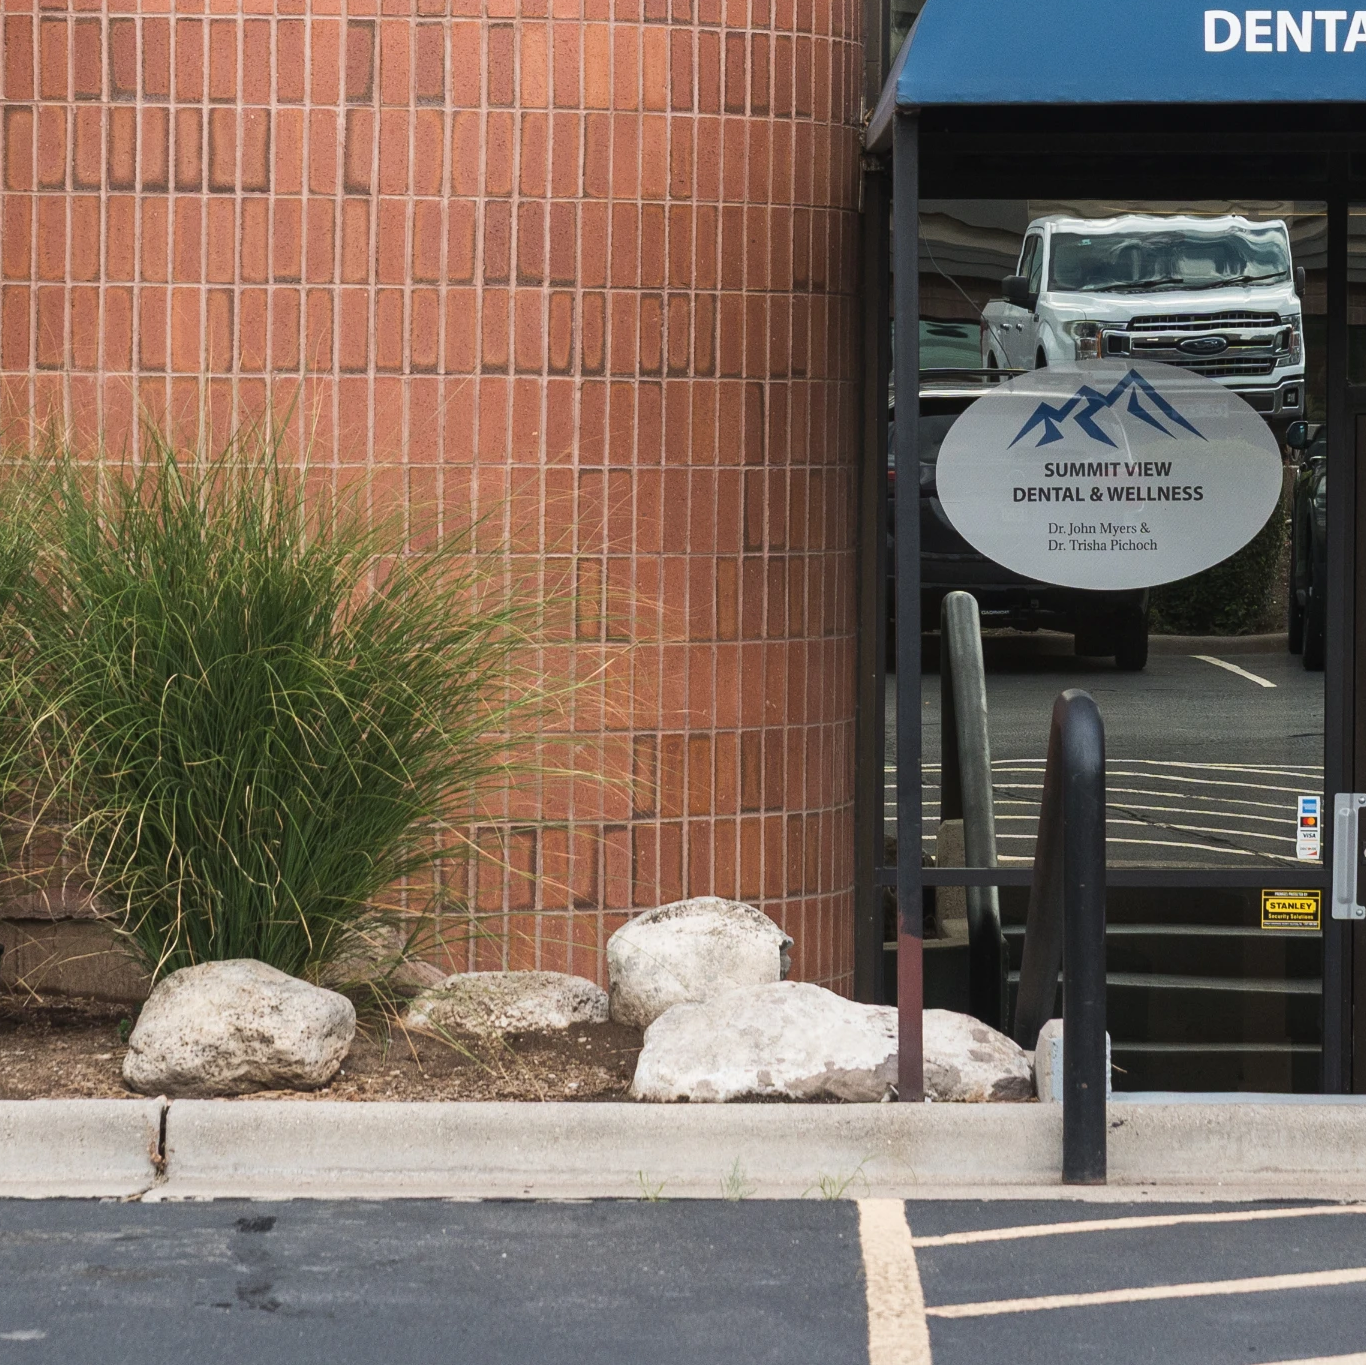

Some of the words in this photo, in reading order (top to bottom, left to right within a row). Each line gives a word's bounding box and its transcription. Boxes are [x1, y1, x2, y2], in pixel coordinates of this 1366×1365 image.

[1044, 462, 1121, 477] SUMMIT
[1124, 461, 1173, 477] VIEW
[1013, 487, 1086, 502] DENTAL
[1089, 486, 1104, 502] &
[1106, 486, 1204, 502] WELLNESS
[1048, 522, 1066, 534] Dr.
[1067, 522, 1096, 536] John
[1100, 522, 1137, 537] Myers
[1139, 521, 1151, 534] &
[1048, 539, 1066, 551] Dr.
[1069, 539, 1107, 551] Trisha
[1110, 539, 1158, 551] Pichoch
[1270, 901, 1313, 910] STANLEY
